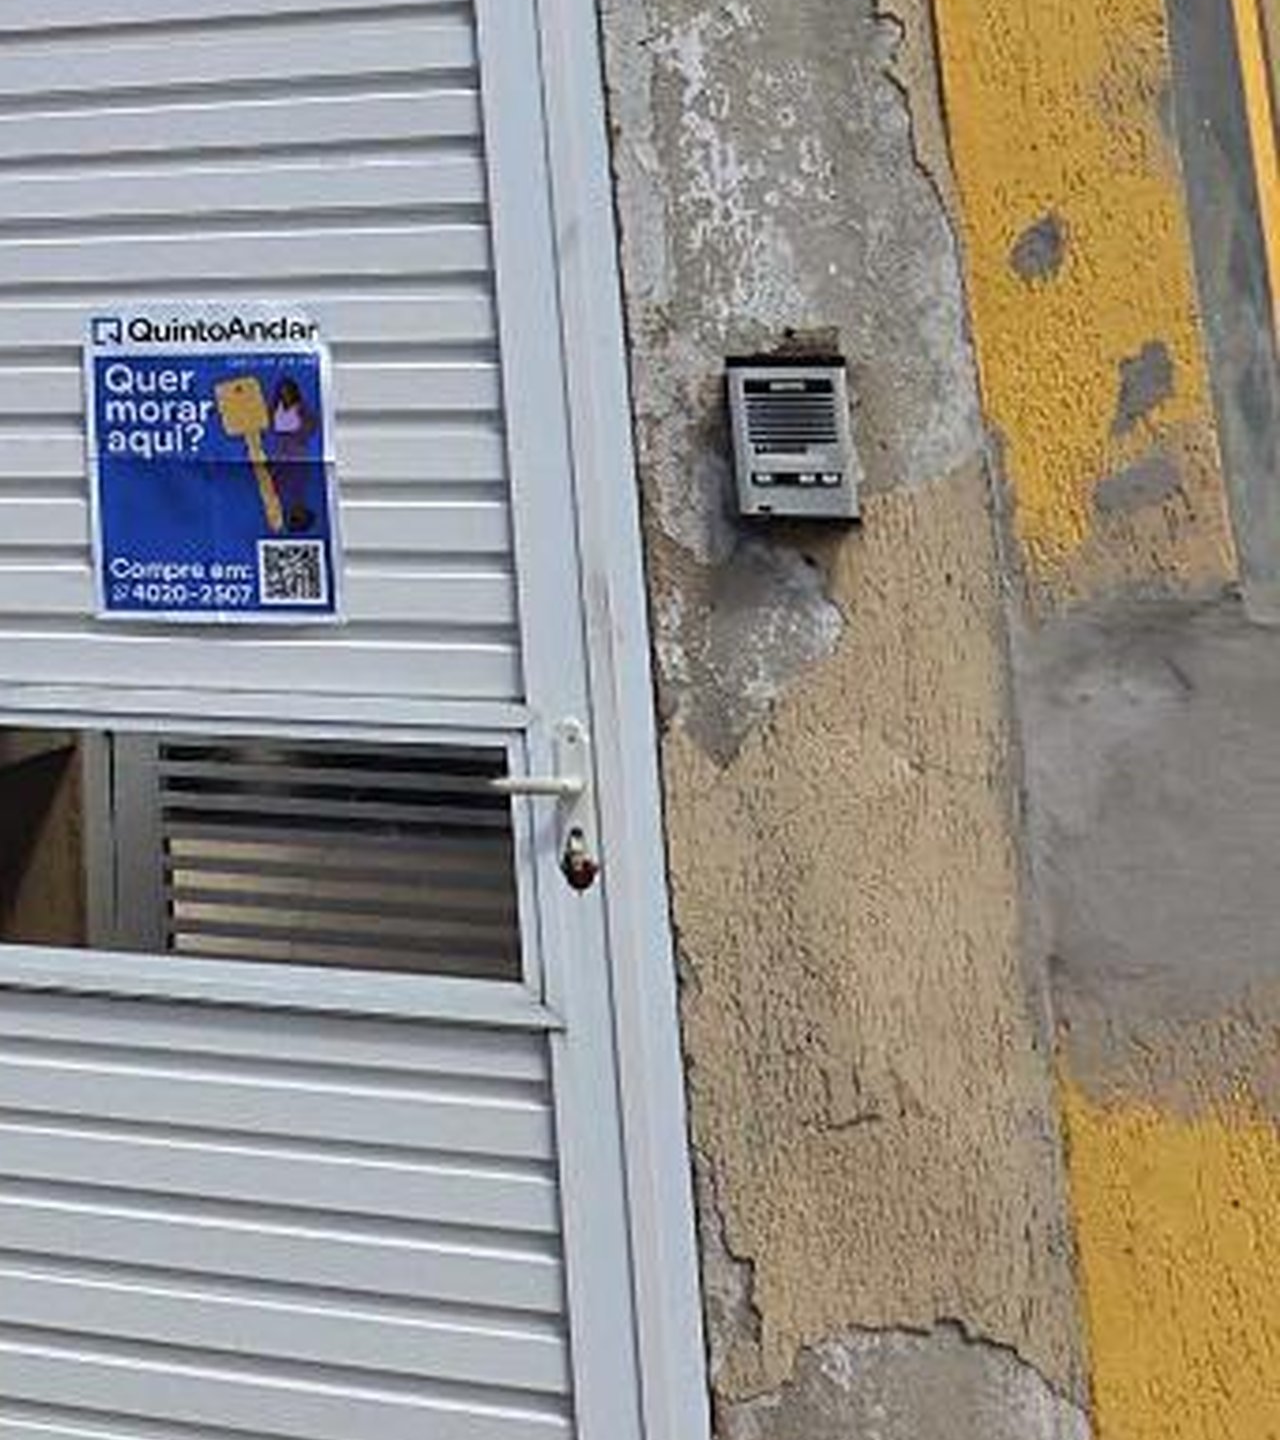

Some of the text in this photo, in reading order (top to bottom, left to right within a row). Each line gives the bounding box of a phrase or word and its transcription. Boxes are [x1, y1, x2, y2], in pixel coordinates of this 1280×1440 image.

[128, 317, 318, 343] QuintoAndar
[105, 363, 194, 394] Quer
[105, 399, 213, 422] morar
[107, 423, 205, 459] aqui?
[109, 557, 205, 581] Compre
